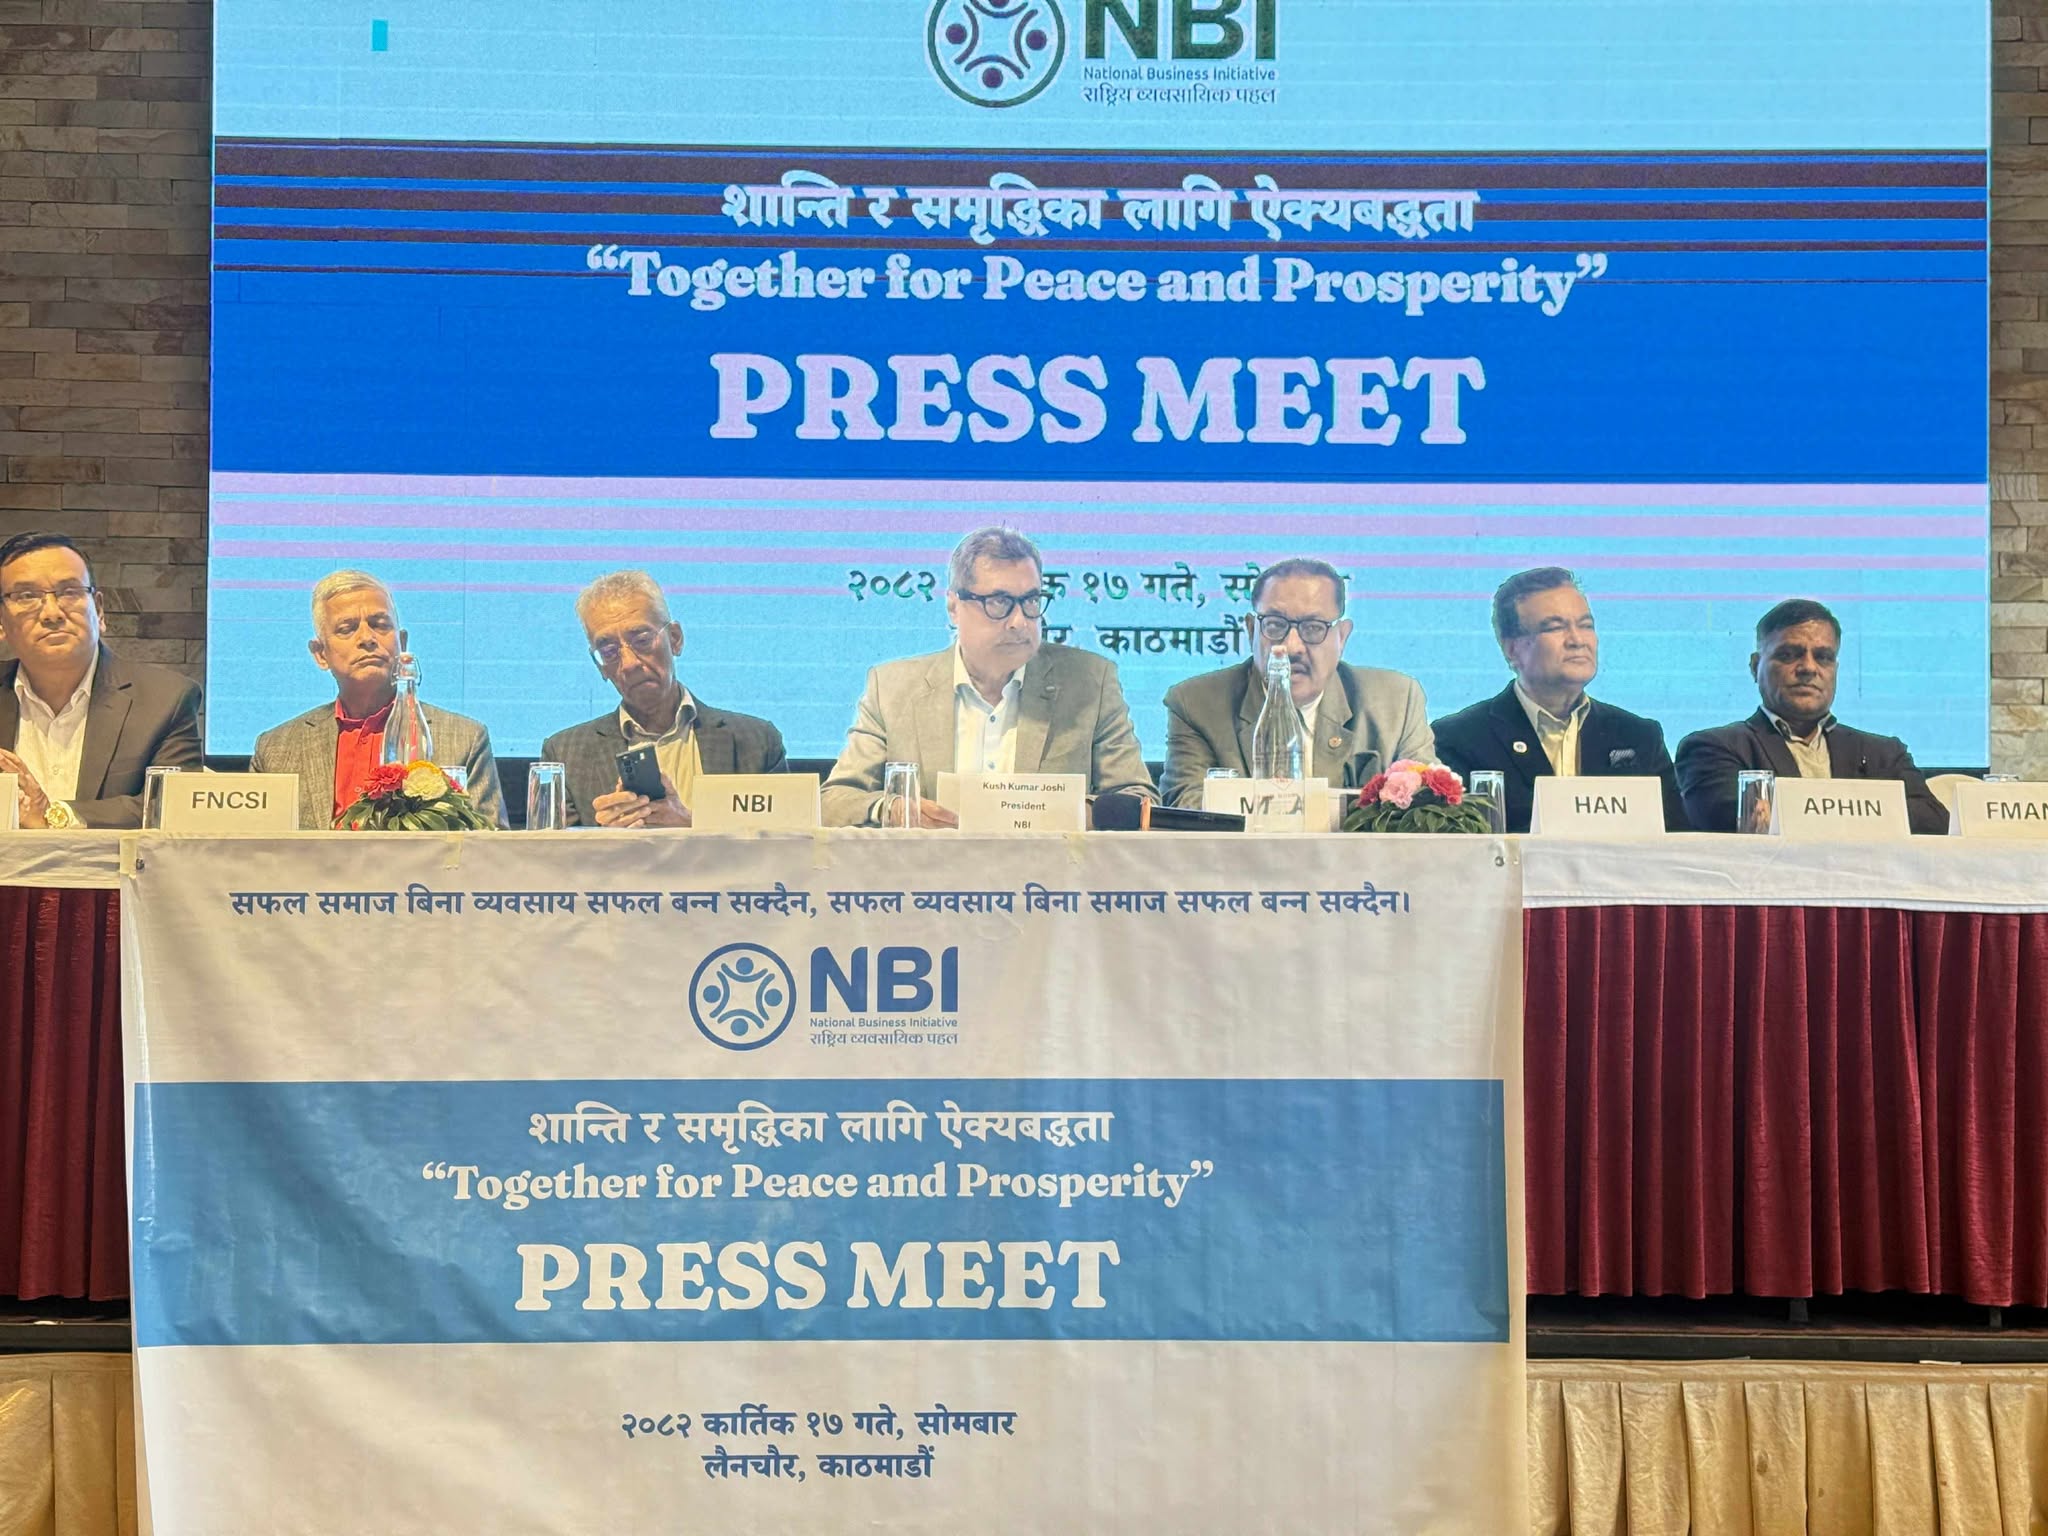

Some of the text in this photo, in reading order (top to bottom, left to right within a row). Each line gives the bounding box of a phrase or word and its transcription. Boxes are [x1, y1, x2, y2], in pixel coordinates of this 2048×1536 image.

[1085, 0, 1276, 59] NBI
[1083, 67, 1275, 80] National Business Initiative
[1236, 87, 1275, 104] पहल
[721, 169, 1480, 245] शान्ति र समृद्धिका लागि ऐक्यबद्धता
[586, 244, 1609, 317] “Together for Peace and Prosperity”
[709, 352, 1487, 447] PRESS MEET
[847, 570, 937, 601] २०८२
[1082, 570, 1129, 604] १७
[1141, 562, 1206, 608] गते,
[1096, 614, 1247, 656] काठमाडौं
[191, 789, 268, 810] FNCSI
[731, 793, 774, 814] NBI
[982, 781, 1066, 793] Kush Kumar Joshi
[1574, 795, 1627, 815] HAN
[1000, 801, 1046, 812] President
[1013, 820, 1031, 829] NBI
[1804, 797, 1882, 817] APHIN
[229, 891, 308, 916] सफल
[316, 891, 398, 915] समाज
[406, 883, 465, 915] बिना
[471, 891, 578, 914] व्यवसाय
[586, 891, 661, 915] सफल
[670, 891, 721, 915] बन्न
[727, 882, 818, 918] सक्दैन,
[827, 891, 905, 914] सफल
[910, 891, 1016, 914] व्यवसाय
[1022, 883, 1079, 914] बिना
[1090, 891, 1168, 914] समाज
[1175, 891, 1250, 914] सफल
[1259, 891, 1309, 913] बन्न
[810, 946, 958, 1013] NBI
[810, 1018, 957, 1028] National Business Initiative
[926, 1032, 958, 1046] पहल
[528, 1099, 1115, 1155] शान्ति र समृद्धिका लागि ऐक्यबद्धता
[422, 1159, 1214, 1211] “Together for Peace and Prosperity”
[514, 1239, 1121, 1311] PRESS MEET
[621, 1403, 1018, 1440] २०८२ कार्तिक १७ गते, सोमबार
[700, 1445, 935, 1482] लैनचौर, काठमाडौं
